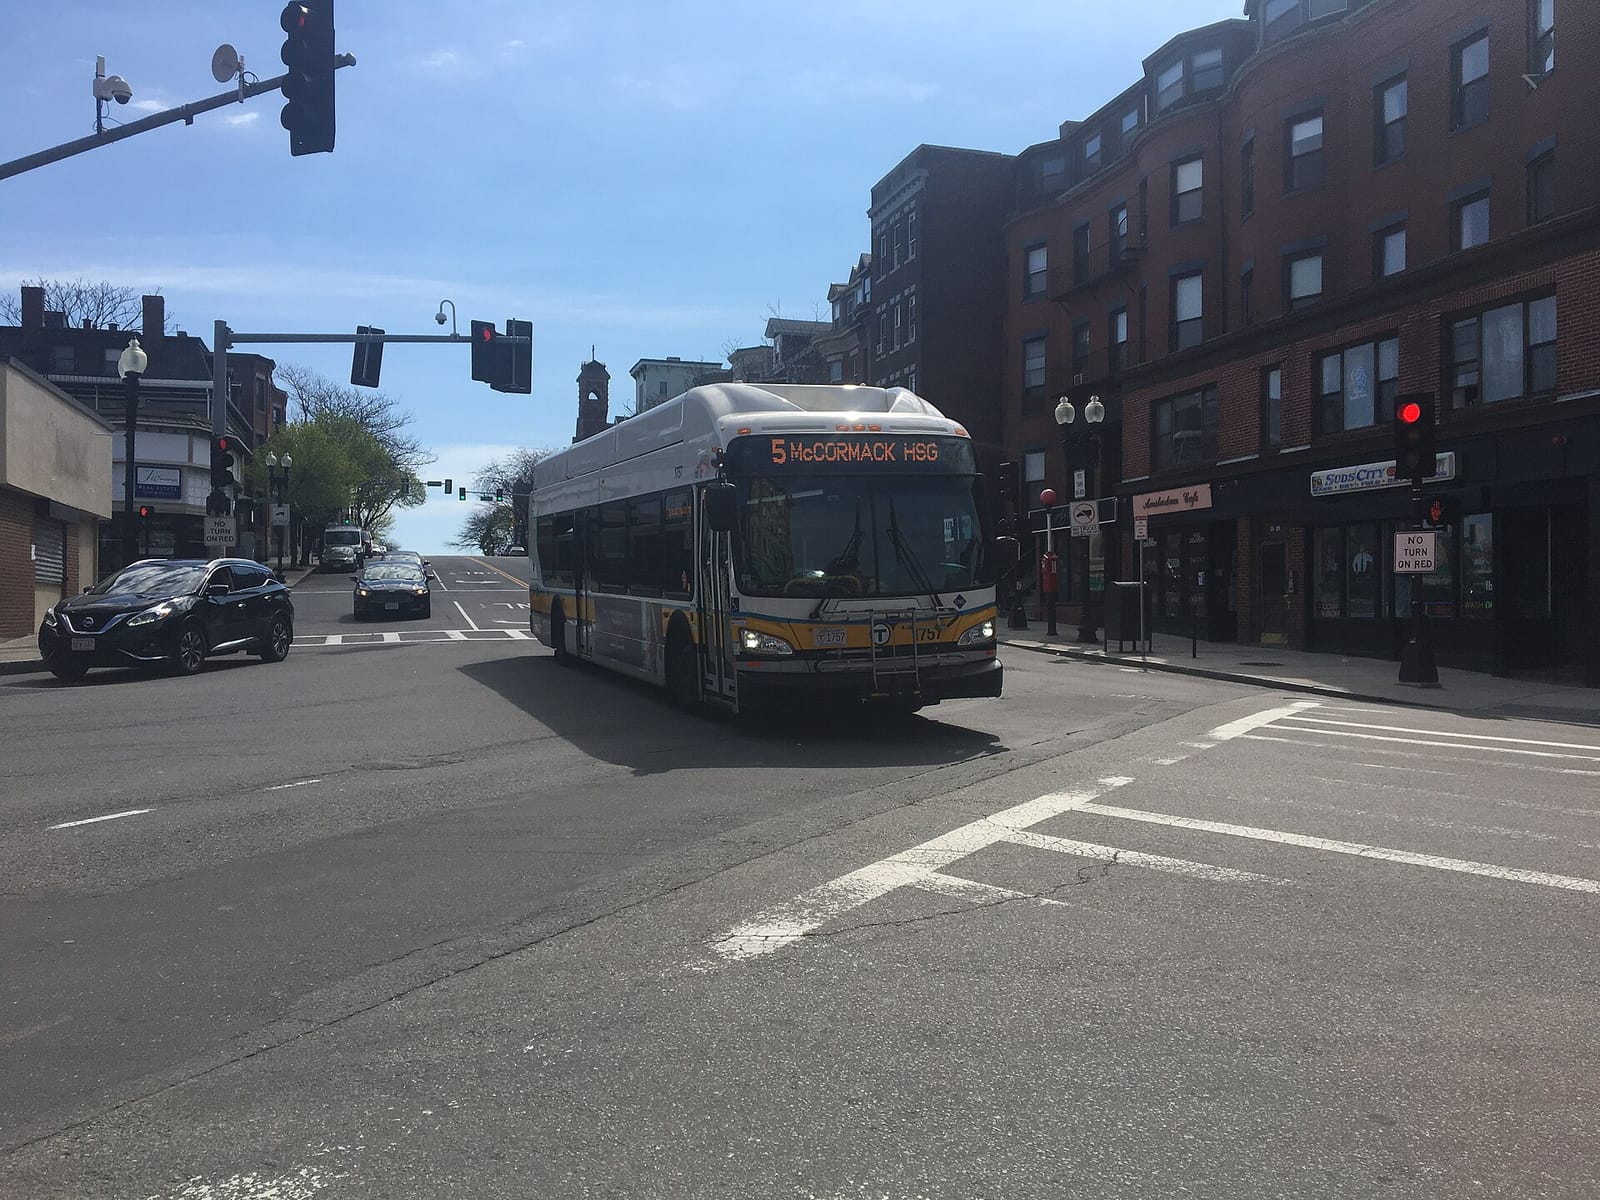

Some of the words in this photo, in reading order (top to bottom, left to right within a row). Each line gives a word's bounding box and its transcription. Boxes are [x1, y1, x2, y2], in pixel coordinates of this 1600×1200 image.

[772, 439, 787, 464] 5
[790, 442, 896, 461] McCORMACK
[904, 442, 938, 461] HSG
[1408, 536, 1423, 545] NO
[1404, 548, 1428, 557] TURN
[1398, 560, 1411, 569] ON
[1414, 559, 1433, 569] RED
[826, 632, 845, 642] 1757
